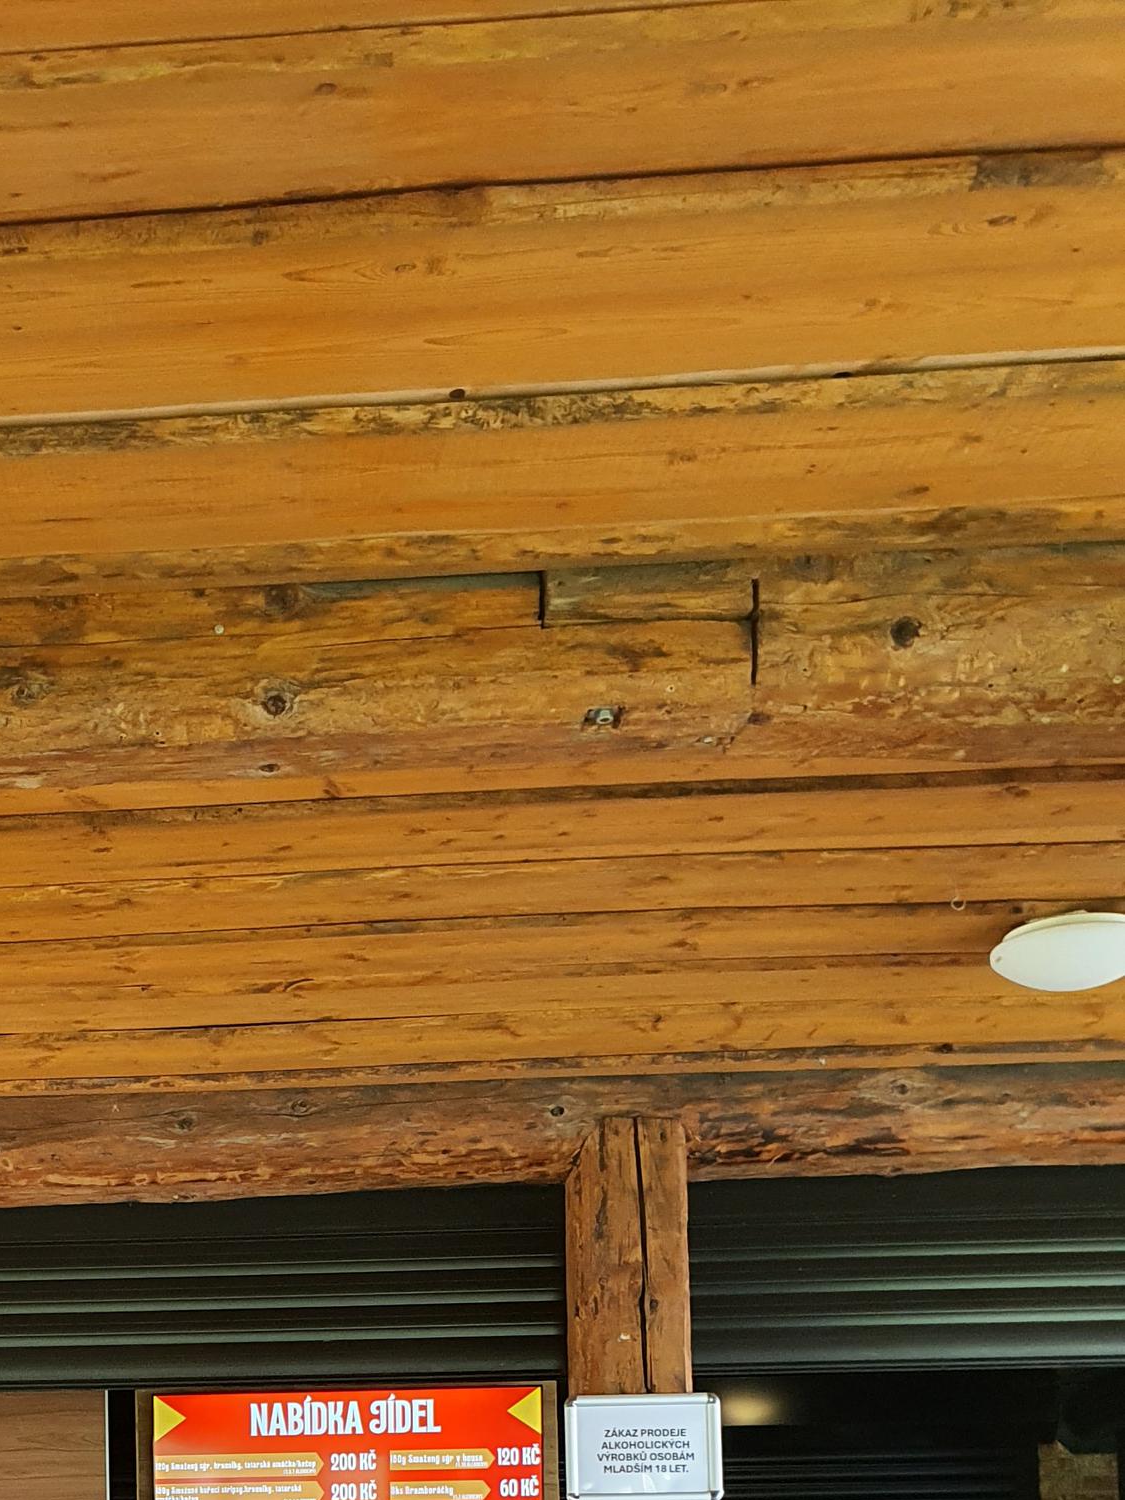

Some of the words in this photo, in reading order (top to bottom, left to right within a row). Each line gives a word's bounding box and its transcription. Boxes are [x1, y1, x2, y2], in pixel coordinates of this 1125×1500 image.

[250, 1395, 364, 1437] NABÍDKA
[369, 1393, 442, 1434] JÍDEL
[604, 1426, 638, 1437] ZÁKAZ
[641, 1428, 687, 1437] PRODEJE
[497, 1447, 519, 1466] 120
[522, 1443, 540, 1466] KČ
[601, 1439, 690, 1450] ALKOHOLICKÝCH
[331, 1453, 356, 1471] 200
[359, 1449, 377, 1470] KČ
[597, 1451, 647, 1461] VÝROBKŮ
[649, 1451, 695, 1461] OSOBÁM
[603, 1463, 652, 1473] MLADŠÍM
[655, 1465, 667, 1473] 18
[669, 1464, 689, 1473] LET.
[331, 1484, 357, 1500] 200
[360, 1480, 377, 1500] KČ
[500, 1479, 519, 1497] 60
[520, 1475, 539, 1497] KČ
